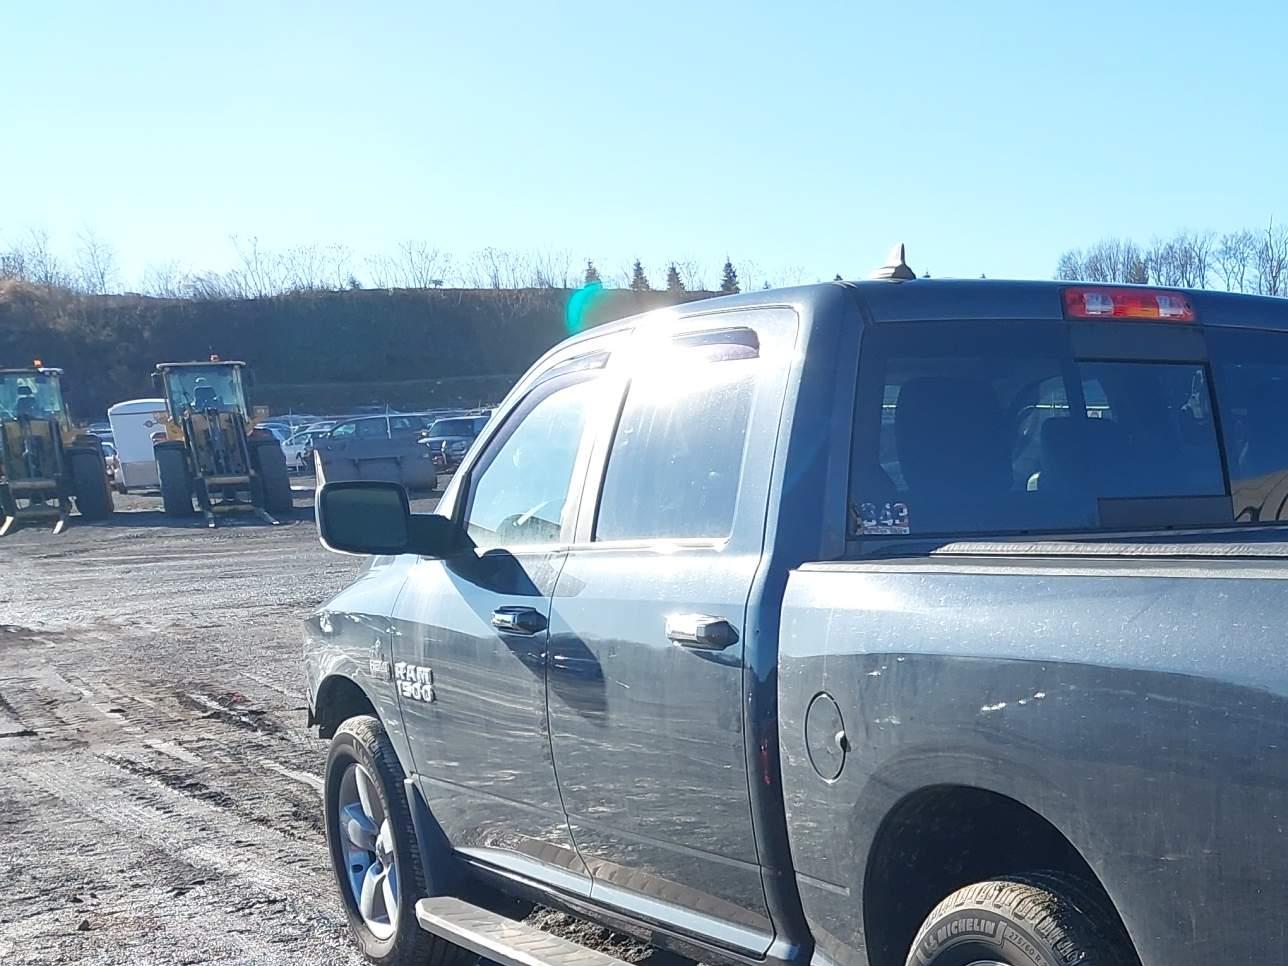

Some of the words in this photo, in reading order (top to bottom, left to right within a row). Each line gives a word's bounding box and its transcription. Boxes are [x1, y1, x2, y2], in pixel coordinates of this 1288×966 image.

[395, 662, 433, 683] RAM
[396, 680, 436, 702] 1500
[937, 918, 996, 943] MICHELIN
